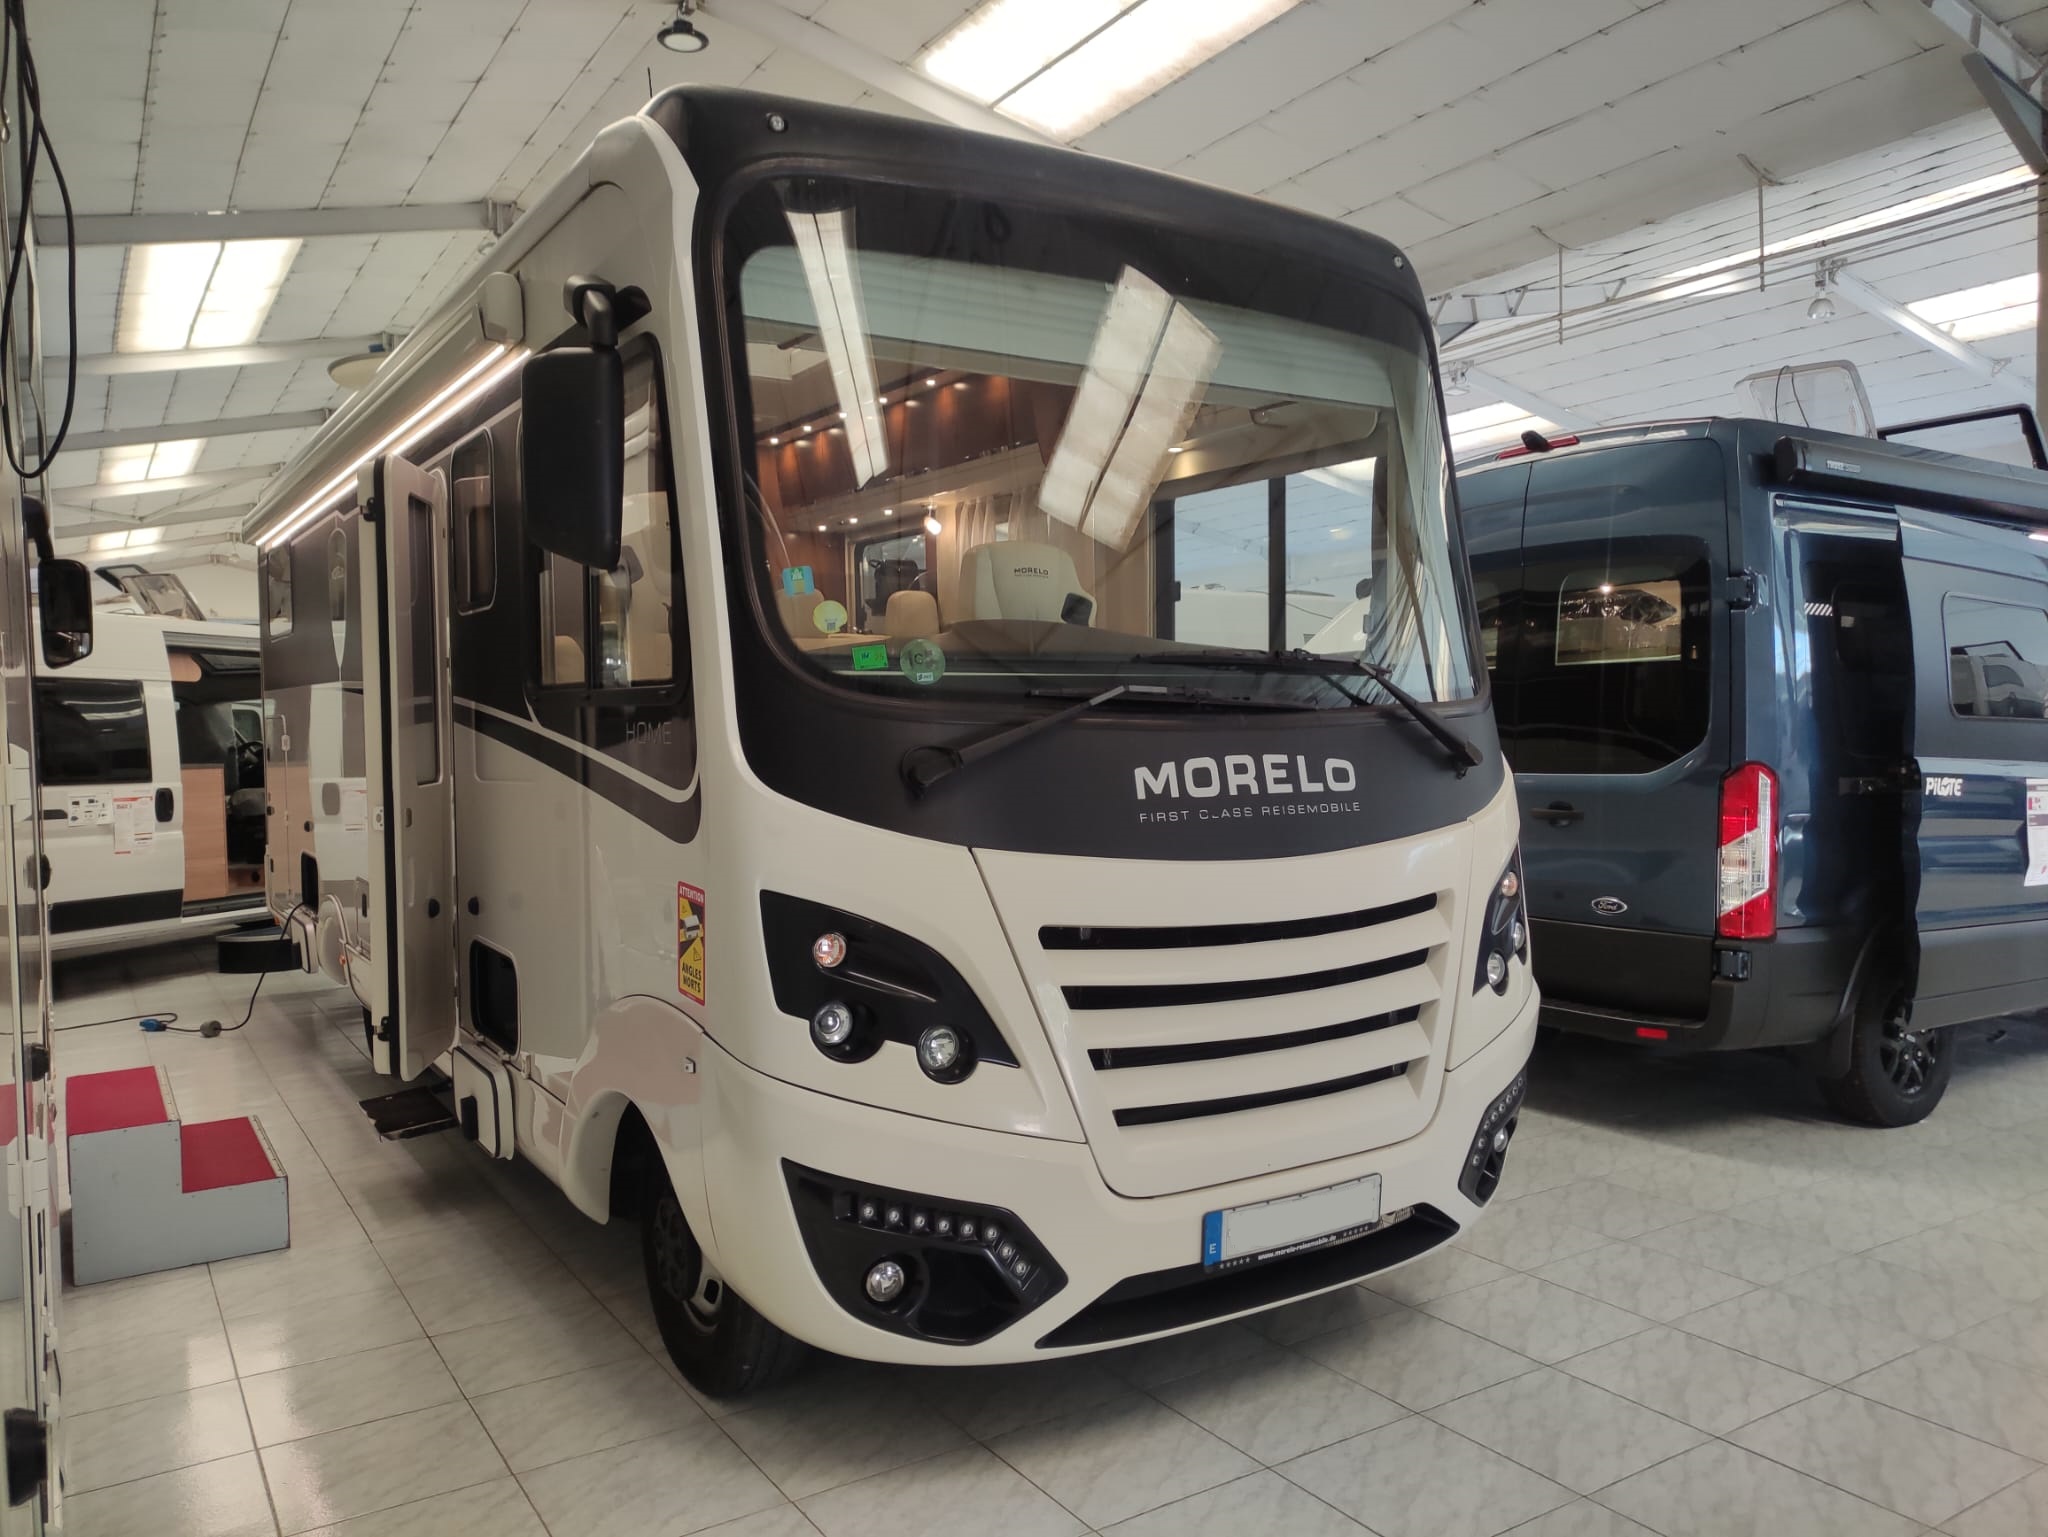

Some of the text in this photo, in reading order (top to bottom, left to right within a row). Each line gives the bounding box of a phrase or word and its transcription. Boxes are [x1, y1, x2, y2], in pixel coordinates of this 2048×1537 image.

[1014, 567, 1049, 576] MORELO
[625, 721, 673, 745] HOME
[1134, 754, 1356, 800] MORELO
[1140, 810, 1190, 823] FIRST
[1261, 801, 1361, 817] REISEMOBILE
[679, 885, 704, 904] ATTENTION
[681, 962, 702, 981] ANGLES
[682, 974, 701, 993] MORTS
[1209, 1243, 1217, 1255] E
